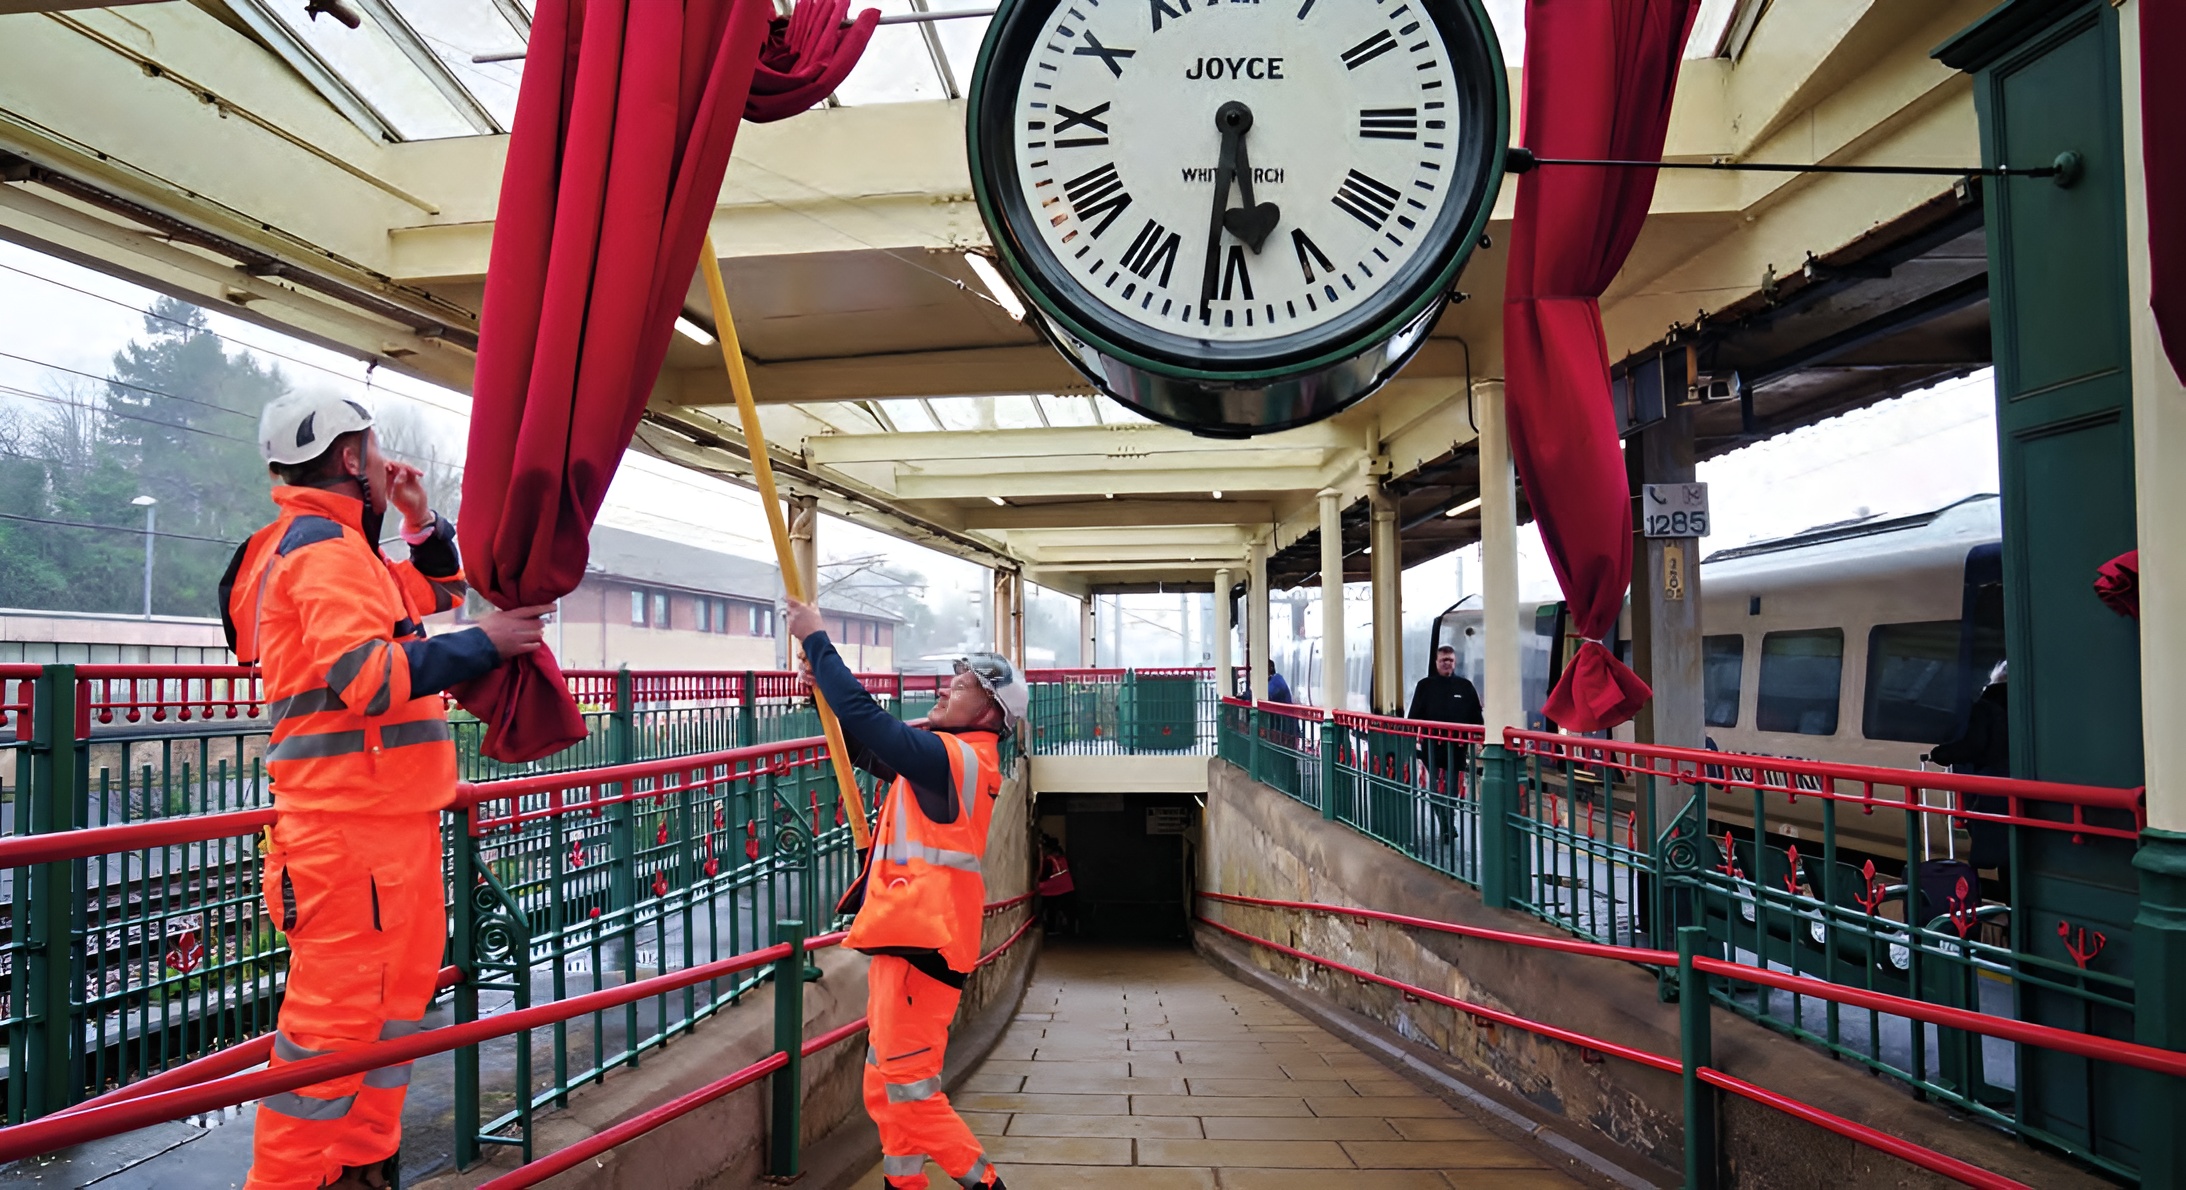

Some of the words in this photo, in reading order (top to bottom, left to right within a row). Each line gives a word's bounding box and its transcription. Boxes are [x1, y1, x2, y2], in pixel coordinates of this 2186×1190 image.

[1186, 57, 1284, 80] JOYCE
[1360, 108, 1417, 140] III
[1646, 511, 1706, 536] 1285
